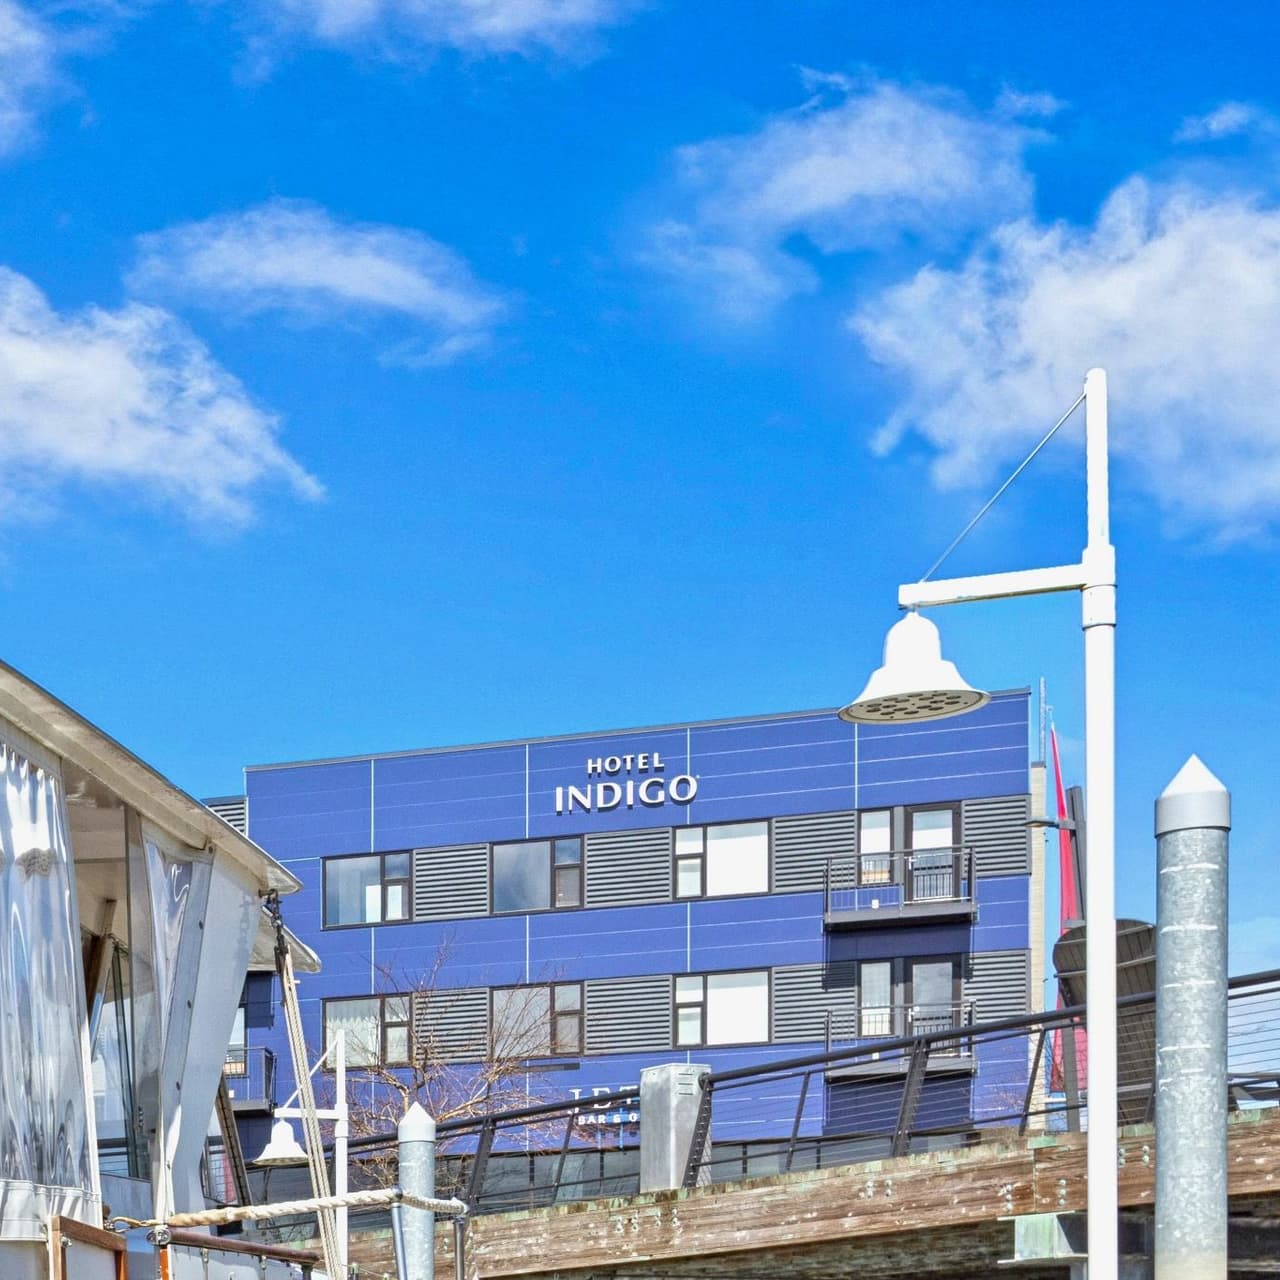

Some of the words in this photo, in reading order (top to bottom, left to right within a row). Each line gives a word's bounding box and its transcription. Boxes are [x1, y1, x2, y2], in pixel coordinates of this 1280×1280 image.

[587, 752, 665, 774] HOTEL
[555, 775, 698, 812] INDIGO
[578, 1114, 606, 1125] BAR
